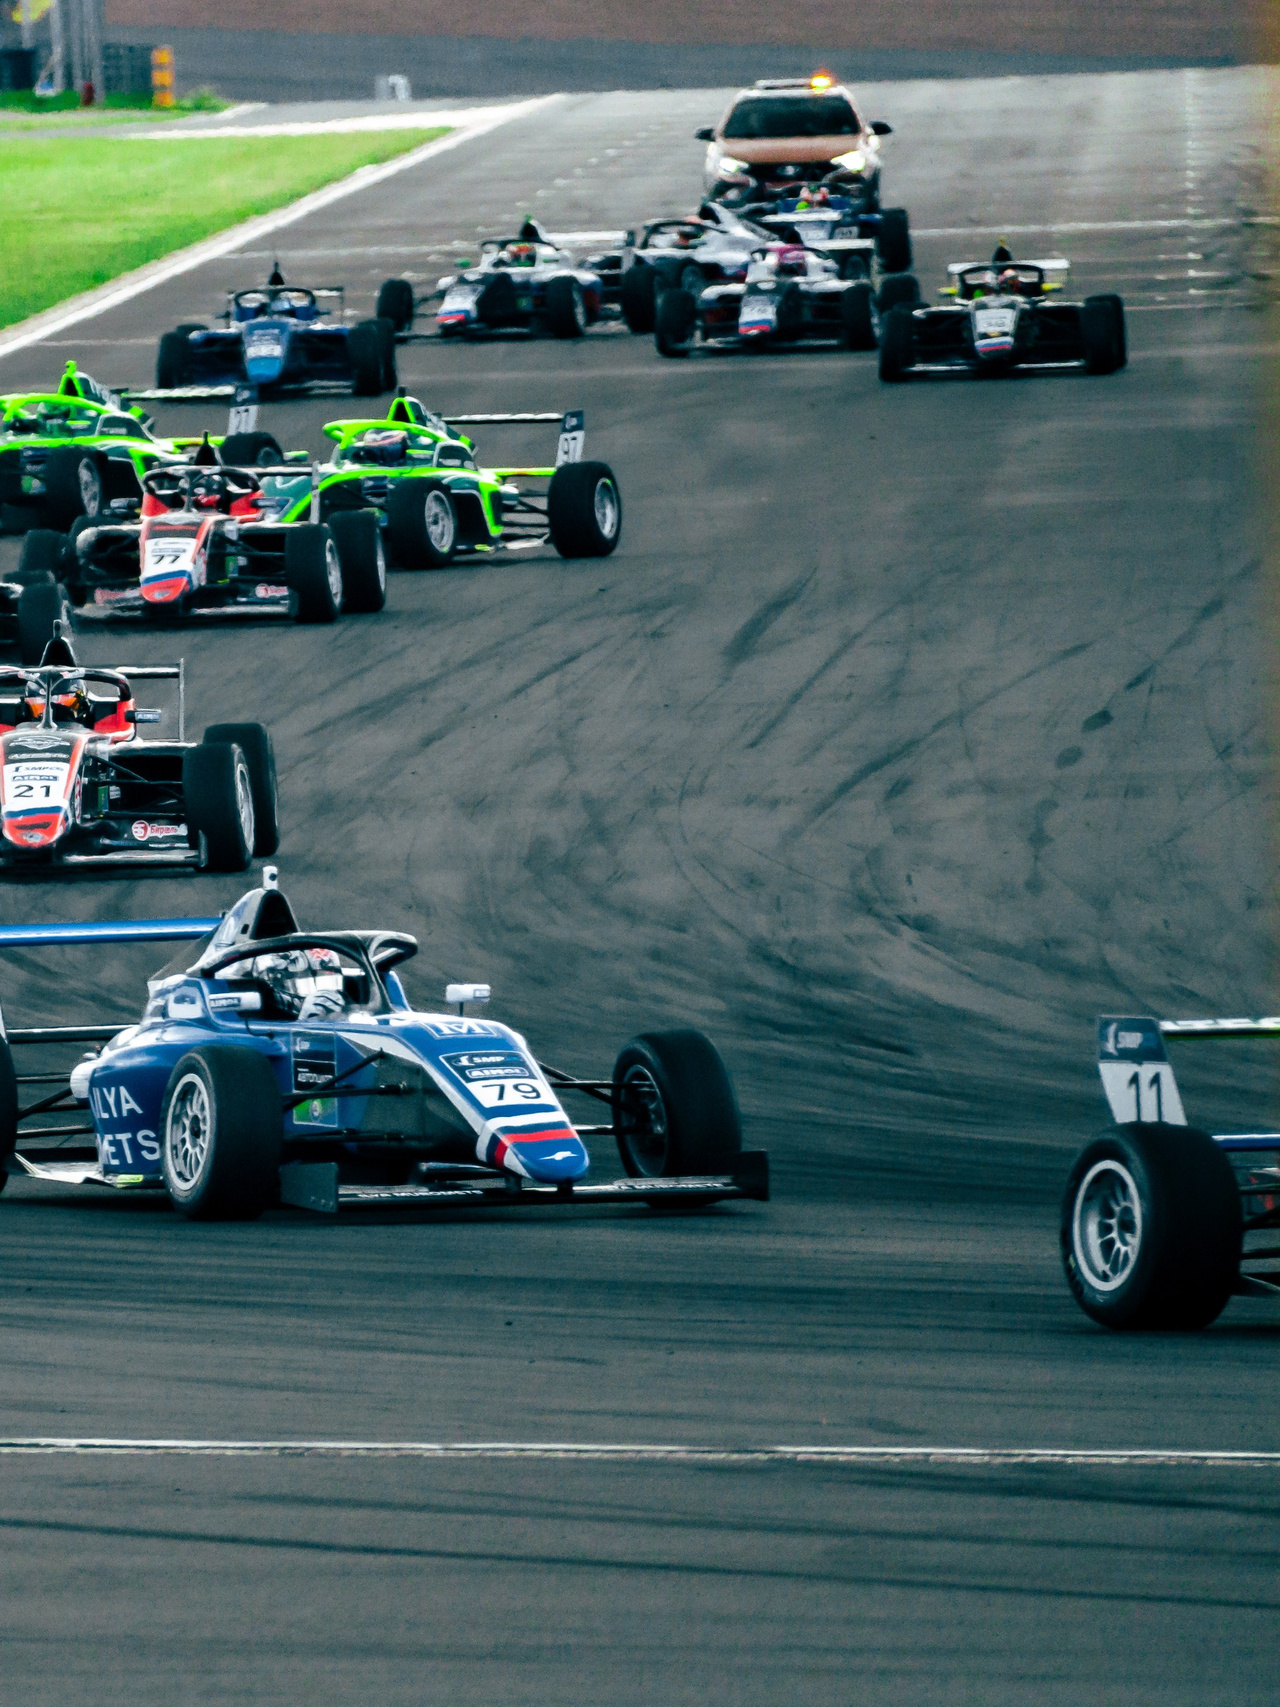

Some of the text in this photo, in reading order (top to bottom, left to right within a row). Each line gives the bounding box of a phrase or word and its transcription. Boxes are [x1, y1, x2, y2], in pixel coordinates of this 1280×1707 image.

[153, 554, 181, 565] 77
[13, 784, 51, 798] 21
[470, 1067, 522, 1077] AIMOL
[481, 1083, 541, 1100] 79
[1128, 1071, 1161, 1122] 11
